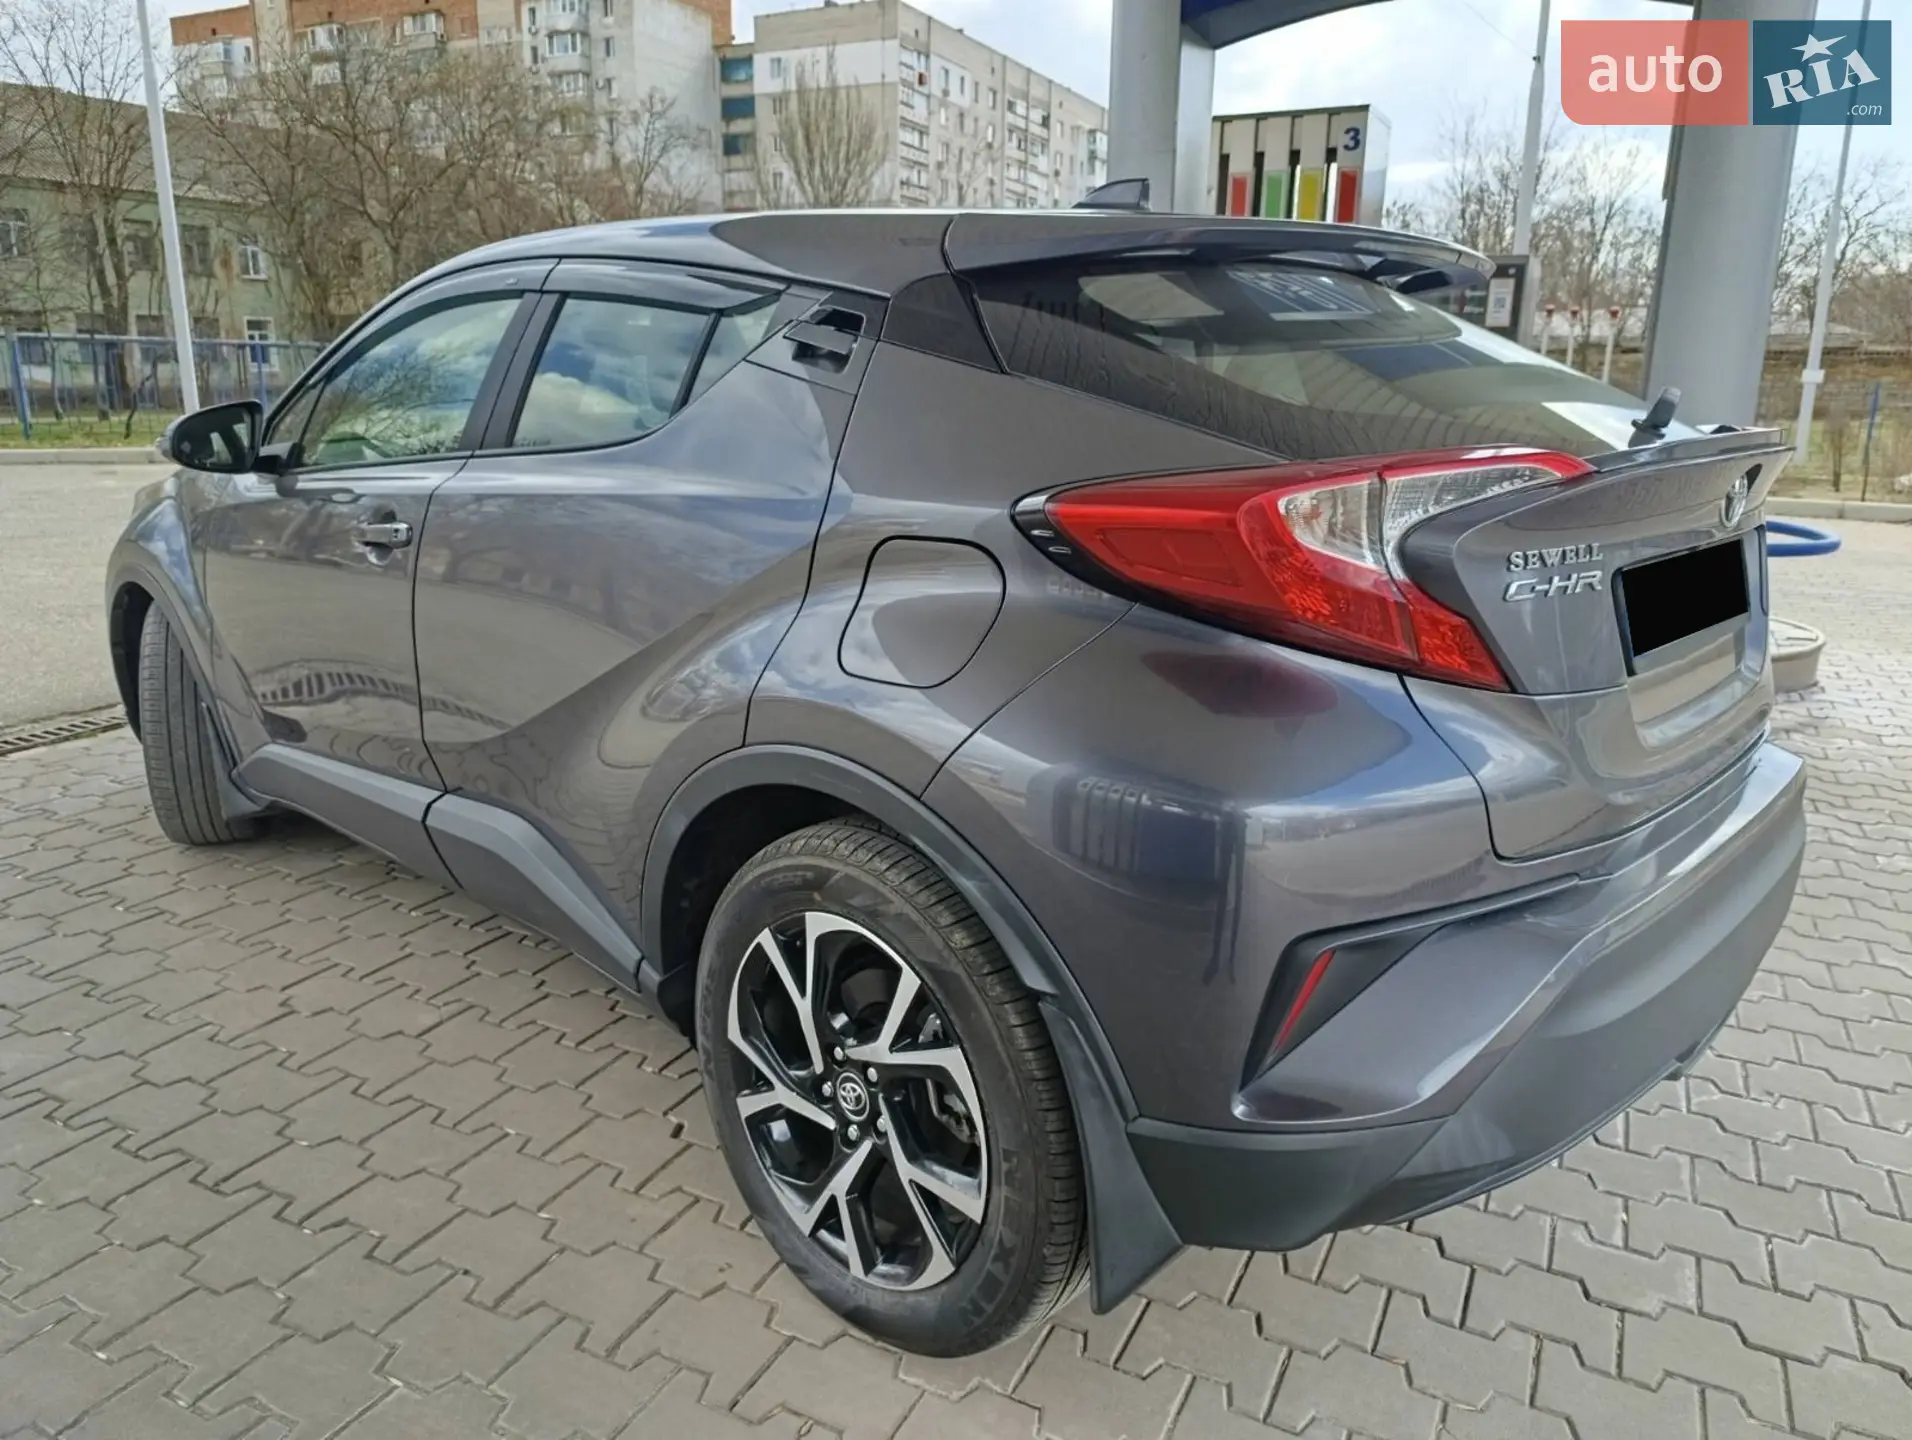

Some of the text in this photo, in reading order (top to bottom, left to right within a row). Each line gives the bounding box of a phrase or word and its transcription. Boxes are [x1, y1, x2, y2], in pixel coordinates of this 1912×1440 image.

[1343, 127, 1361, 151] 3
[1508, 543, 1604, 572] SEWELL
[1504, 570, 1602, 601] C-HR
